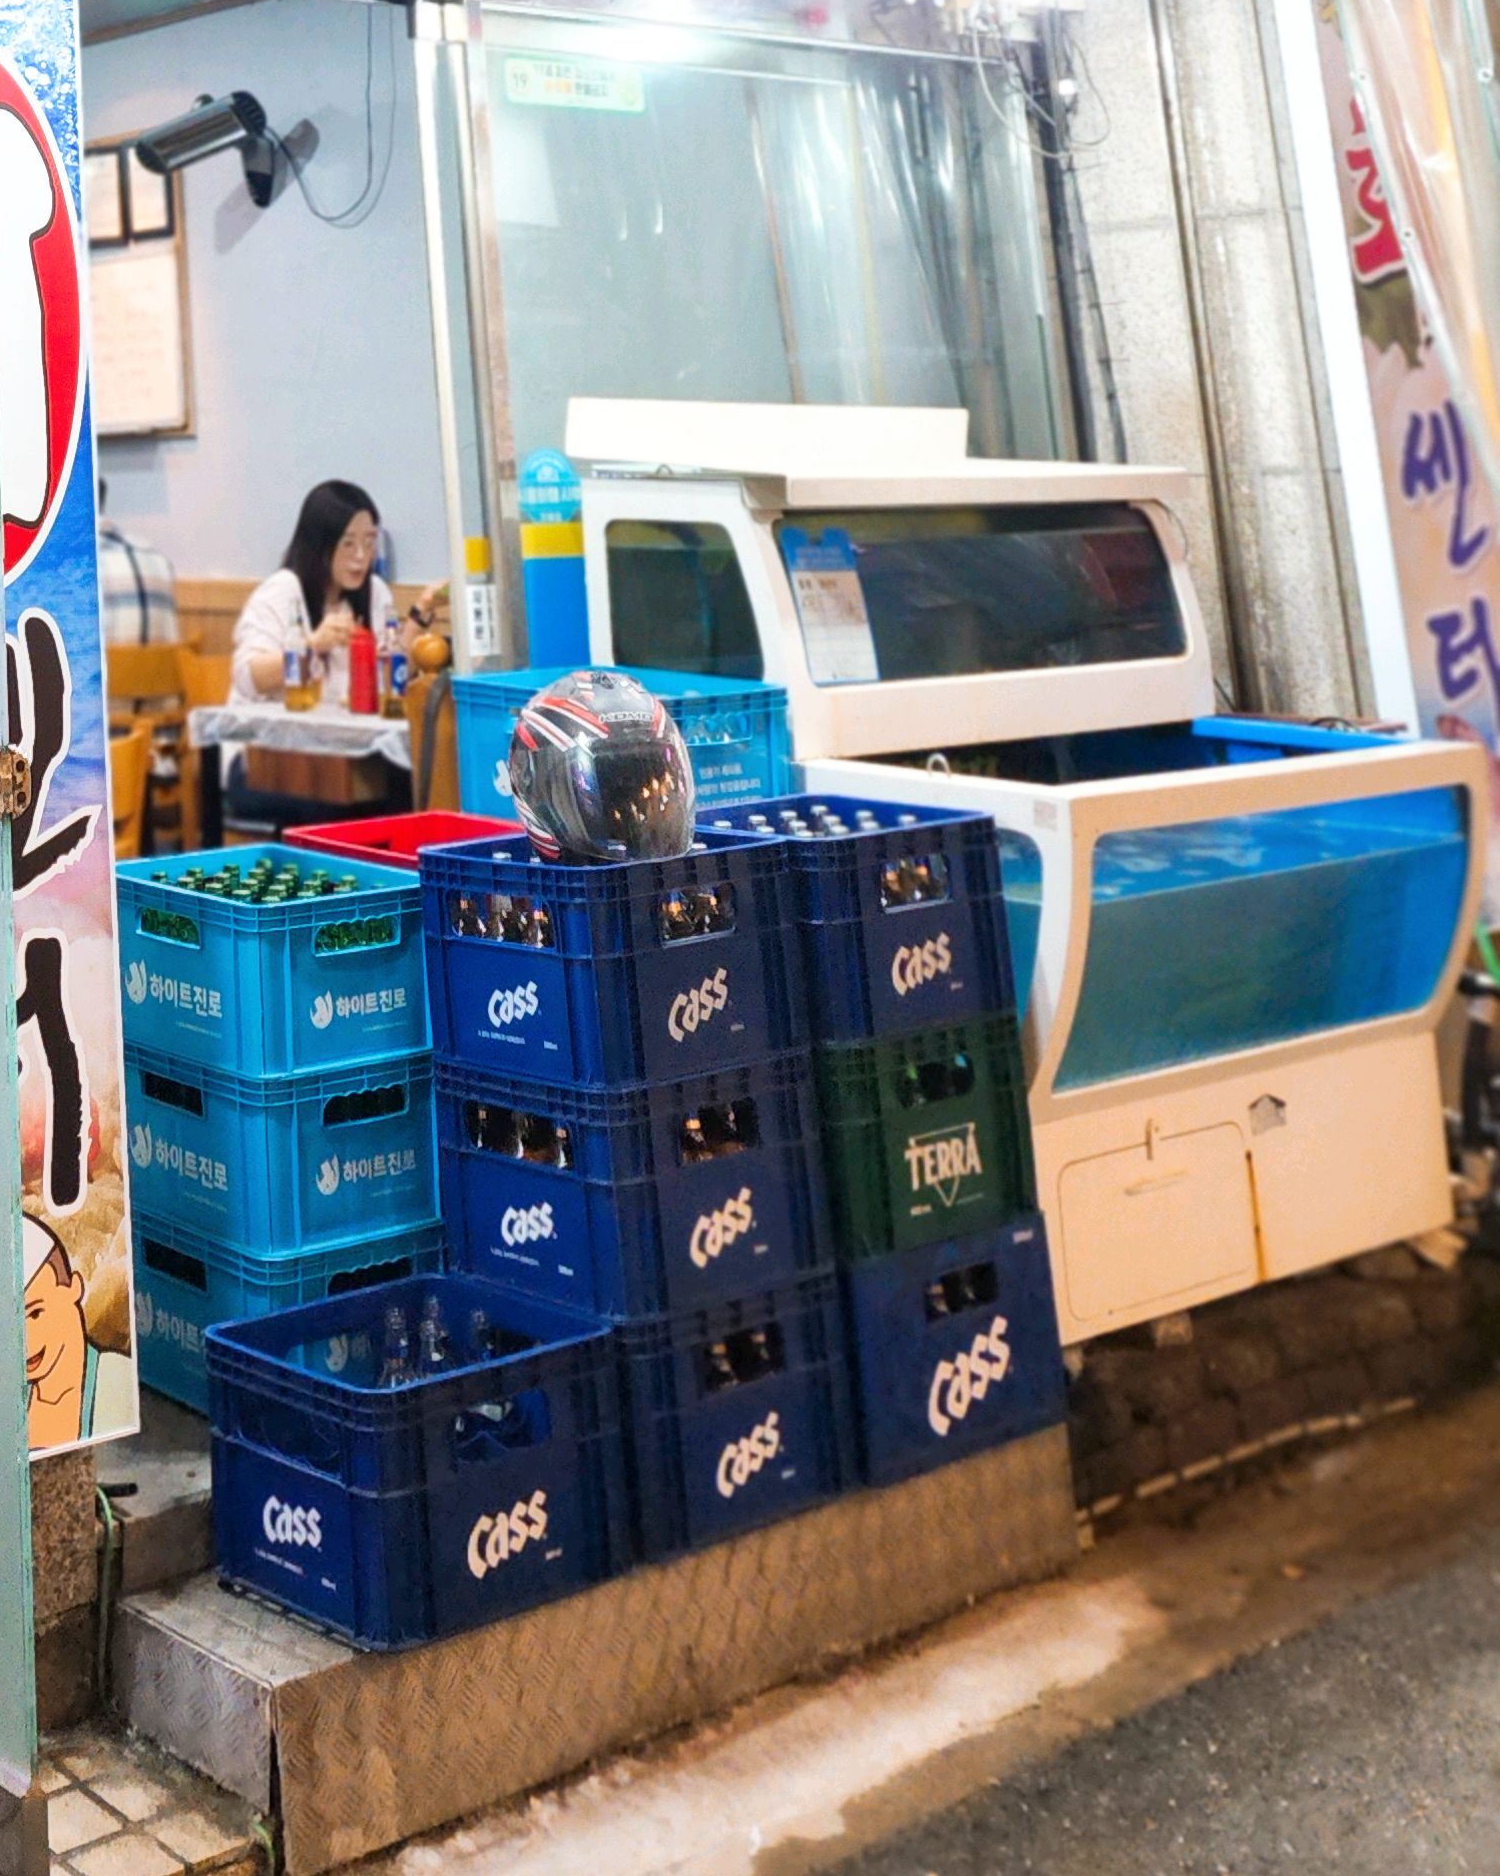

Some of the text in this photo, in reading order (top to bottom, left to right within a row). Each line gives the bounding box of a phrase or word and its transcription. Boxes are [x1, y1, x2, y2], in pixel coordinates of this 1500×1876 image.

[149, 973, 223, 1019] 하이트진로
[892, 931, 952, 997] Cass
[335, 987, 407, 1019] 하이트진로
[668, 967, 728, 1043] Cass
[155, 1138, 229, 1192] 하이트진로
[342, 1148, 418, 1185] 하이트진로
[904, 1122, 982, 1191] TERRA
[689, 1186, 753, 1269] Cass
[155, 1307, 206, 1355] 하이트
[928, 1314, 1010, 1437] Cass
[717, 1410, 780, 1499] Cass
[262, 1495, 322, 1548] Cass
[467, 1489, 548, 1580] Cass
